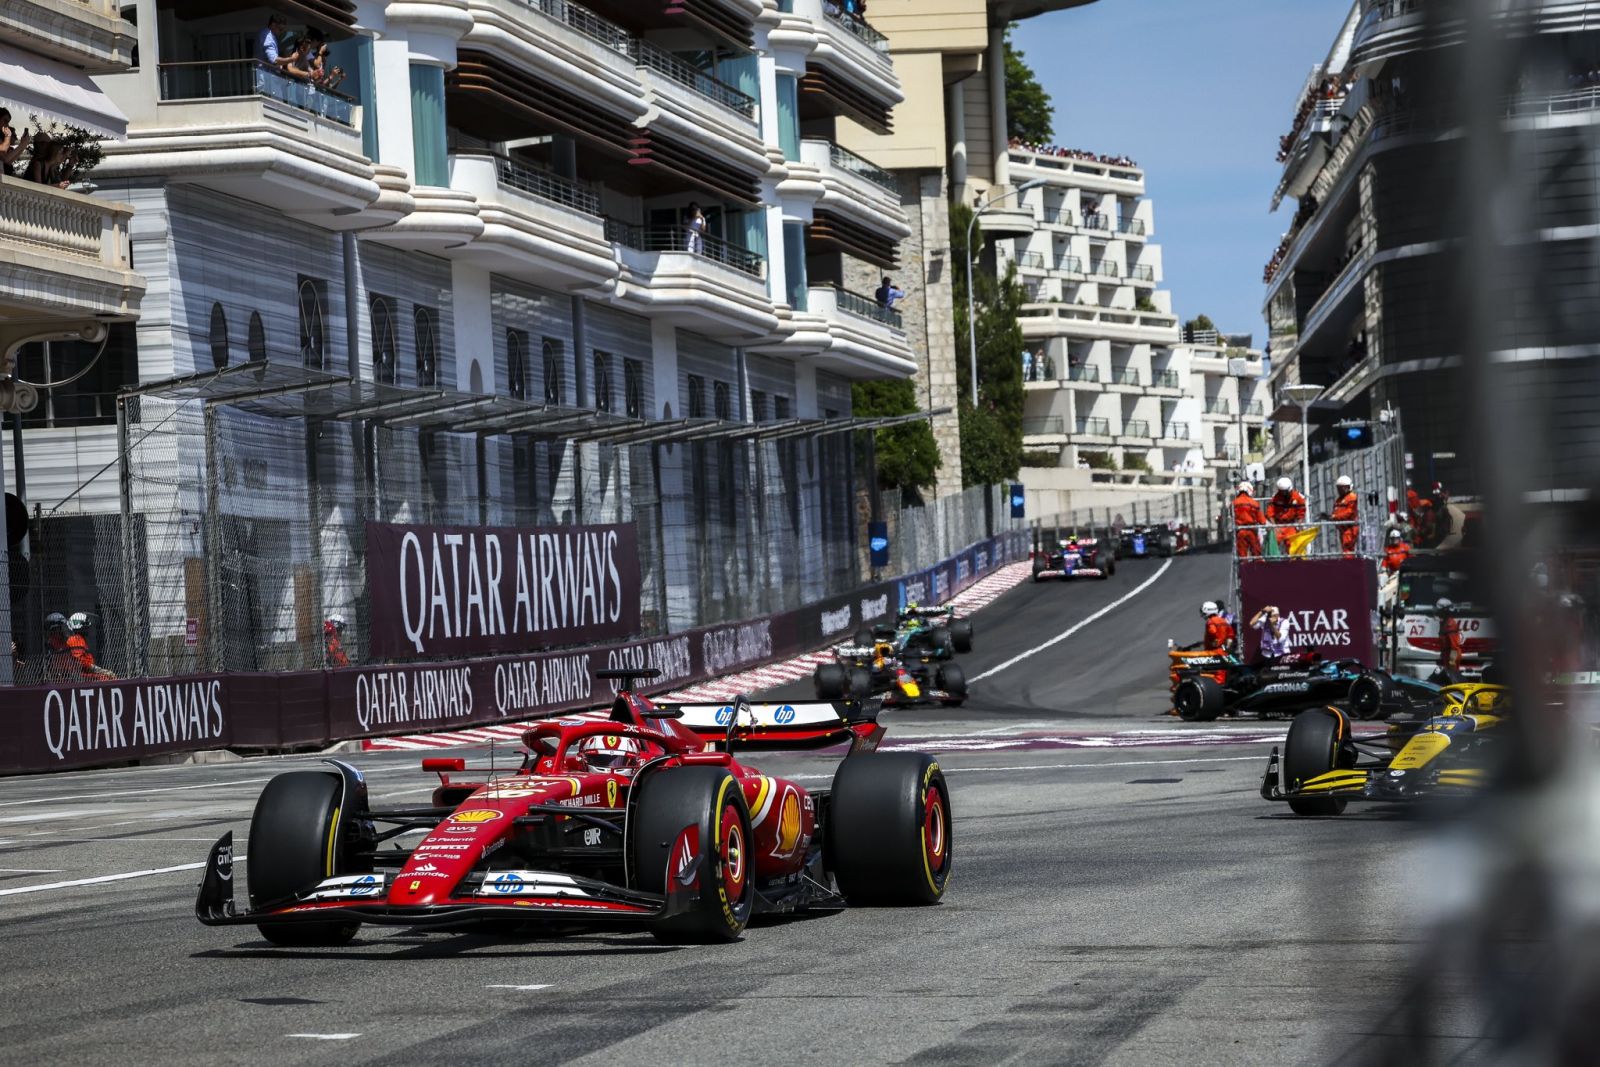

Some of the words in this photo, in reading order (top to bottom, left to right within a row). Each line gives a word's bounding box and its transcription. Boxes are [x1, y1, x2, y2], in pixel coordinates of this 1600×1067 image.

[400, 531, 506, 653] QATAR
[513, 529, 621, 634] AIRWAYS
[1288, 609, 1350, 631] ATAR
[1410, 625, 1425, 636] A7
[495, 661, 540, 716] QATAR
[541, 655, 591, 705] AIRWAYS
[356, 672, 409, 731] QATAR
[412, 666, 473, 720] AIRWAYS
[44, 688, 127, 760] QATAR
[132, 679, 223, 746] AIRWAYS
[716, 706, 733, 725] hp
[775, 705, 795, 724] hp
[585, 793, 601, 804] MILLE
